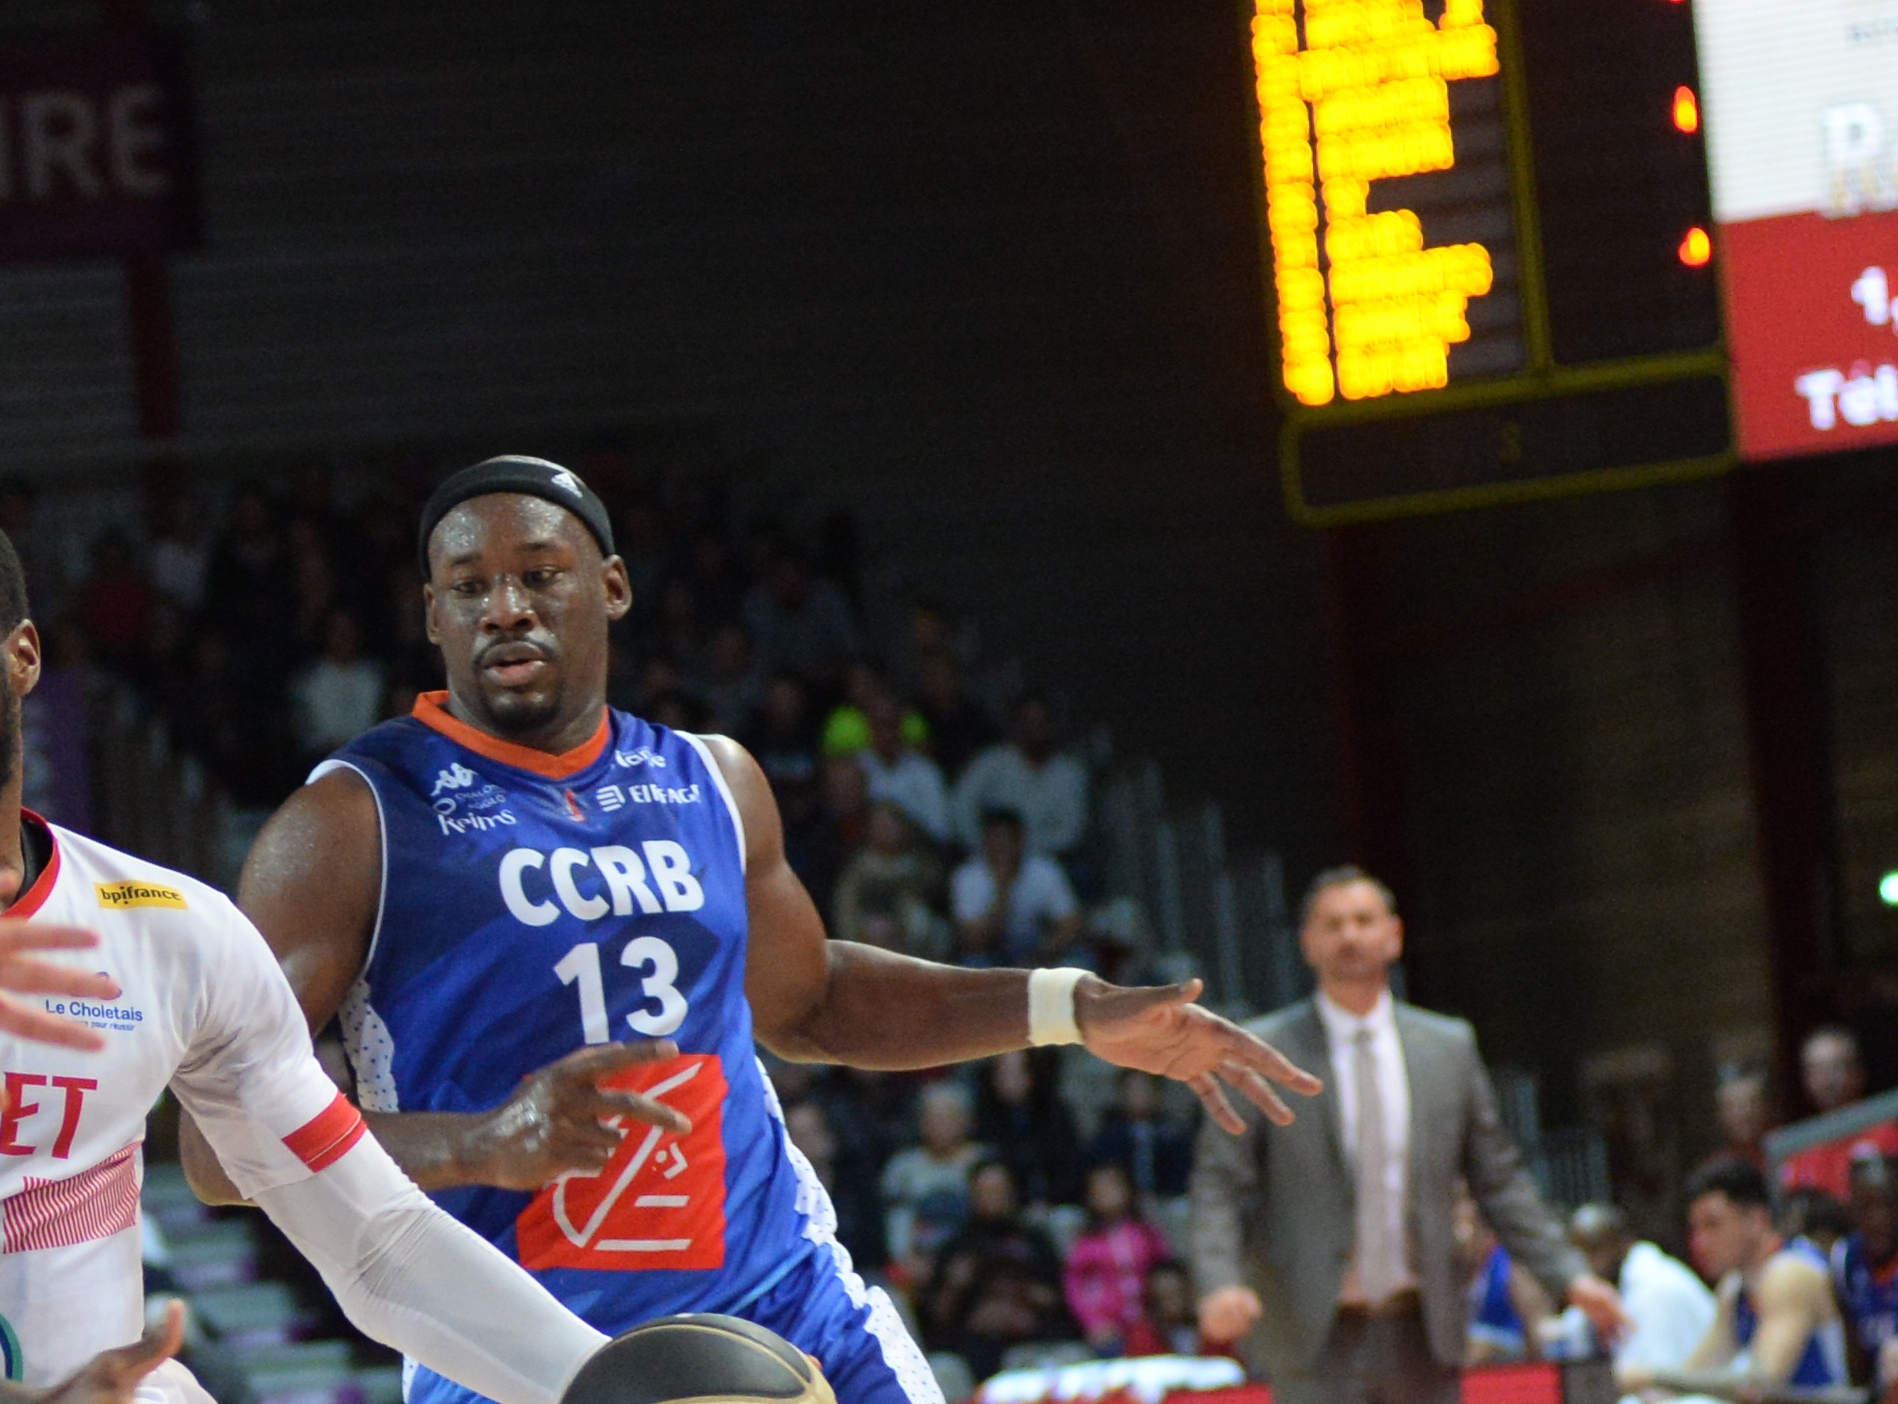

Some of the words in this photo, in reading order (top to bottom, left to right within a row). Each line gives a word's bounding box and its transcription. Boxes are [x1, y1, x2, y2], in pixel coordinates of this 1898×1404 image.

[101, 886, 182, 905] bpifrance
[499, 840, 705, 926] CCRB
[45, 1000, 65, 1014] Le
[69, 1001, 143, 1021] Choletais
[554, 936, 688, 1044] 13
